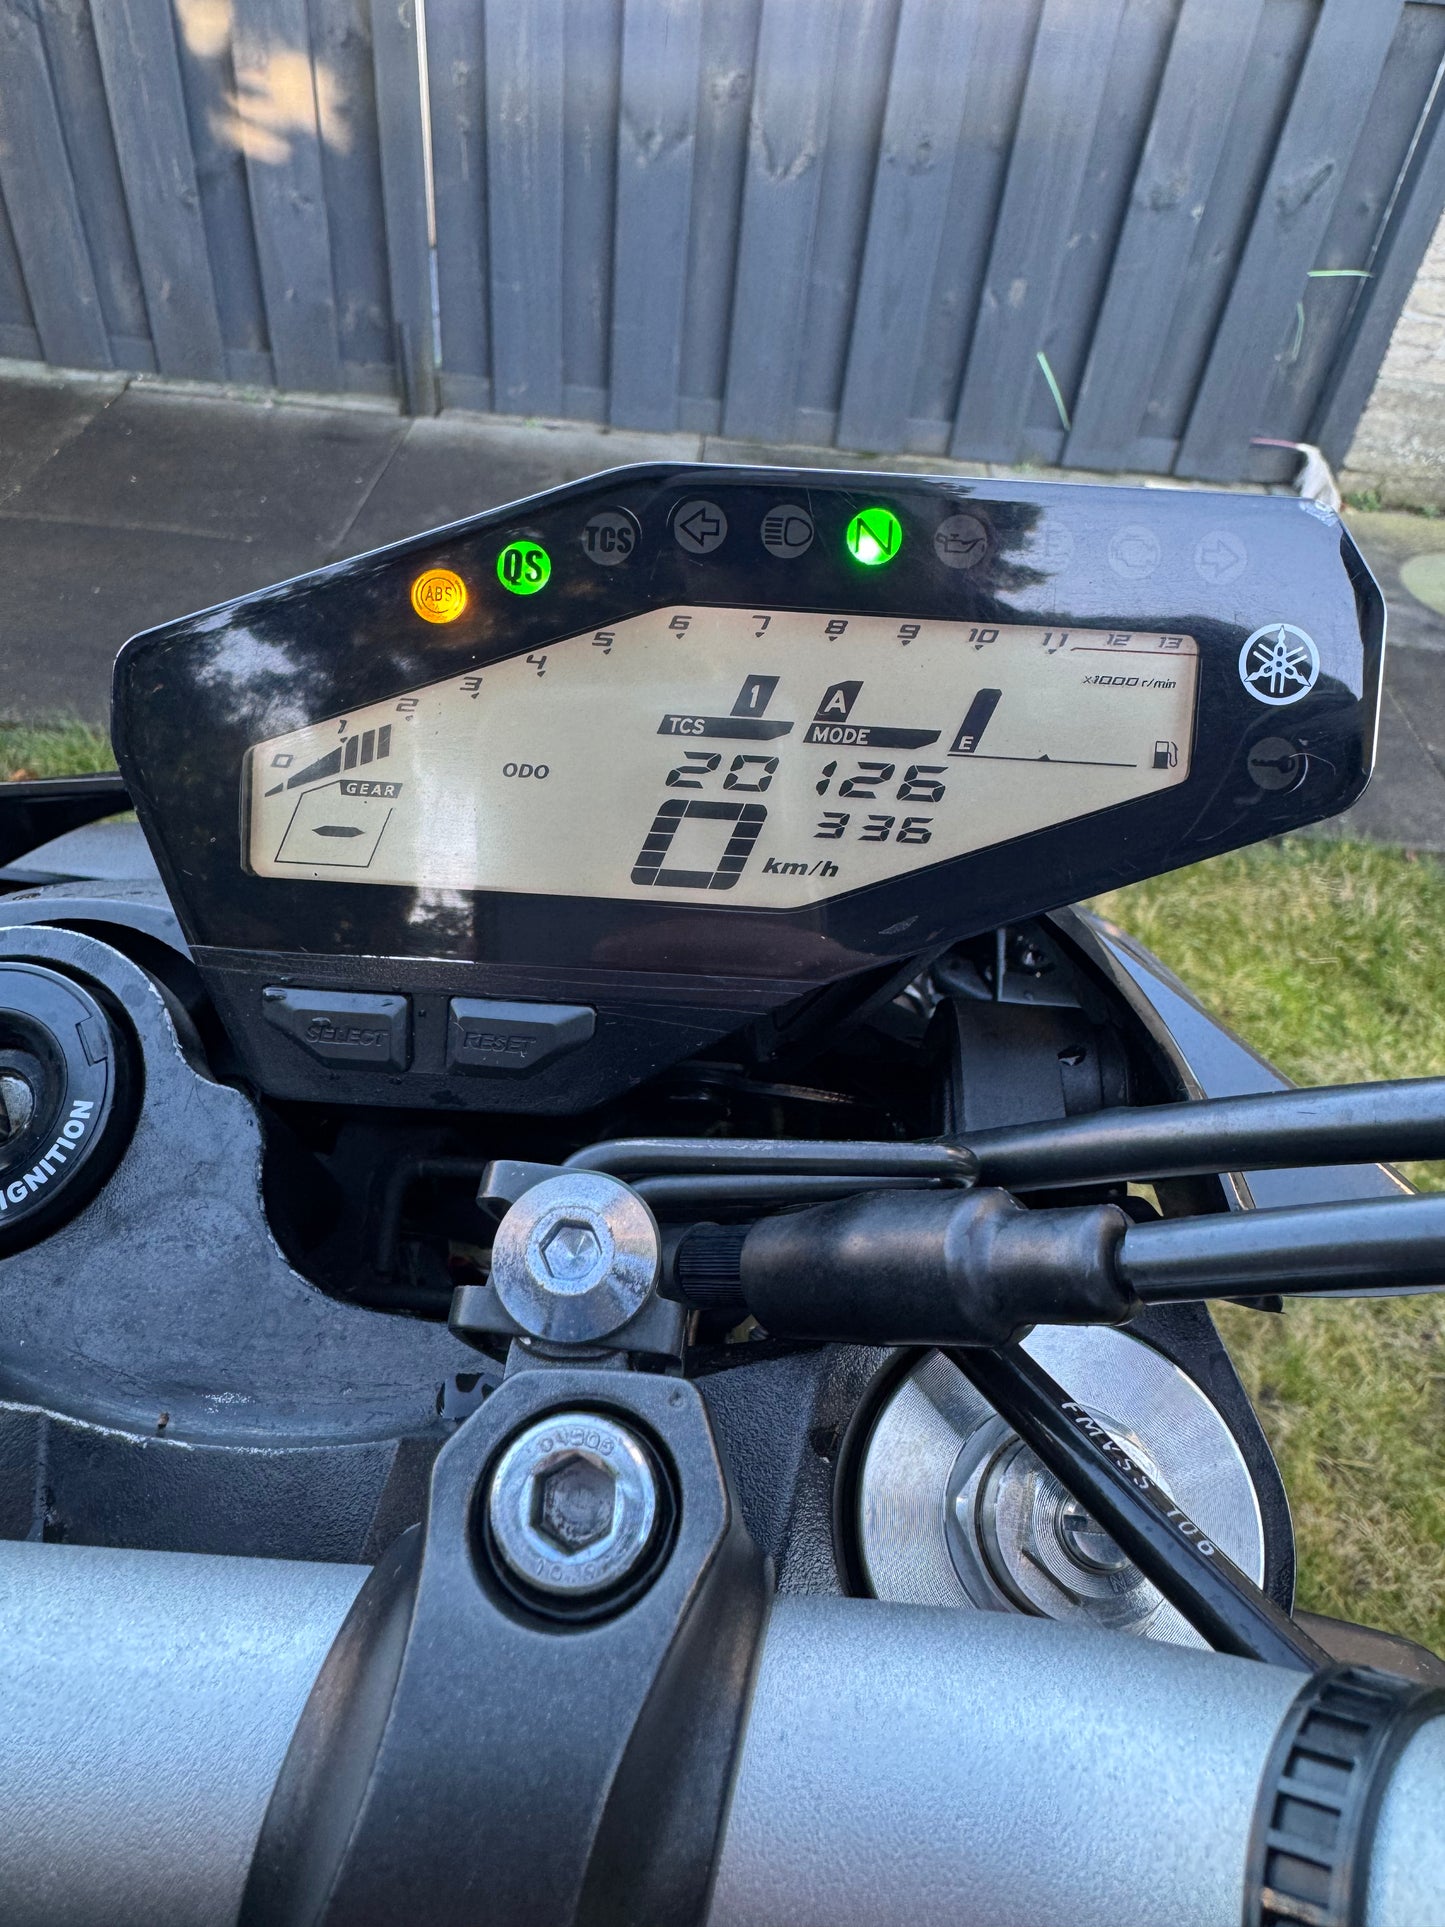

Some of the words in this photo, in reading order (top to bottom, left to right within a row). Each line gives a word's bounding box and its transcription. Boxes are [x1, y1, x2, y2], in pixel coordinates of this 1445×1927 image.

[586, 526, 632, 553] TCS
[854, 516, 893, 557] N
[503, 549, 544, 585] QS
[425, 586, 452, 602] ABS
[669, 615, 692, 630] 6
[752, 615, 772, 630] 7
[824, 620, 848, 634] 8
[897, 624, 921, 639] 9
[968, 628, 999, 643] 10
[592, 632, 616, 647] 5
[1042, 632, 1068, 647] 11
[1105, 633, 1132, 646] 12
[1158, 636, 1183, 649] 13
[526, 654, 547, 669] 4
[460, 676, 483, 691] 3
[1141, 679, 1176, 689] r/min
[749, 684, 760, 708] 1
[824, 690, 847, 714] A
[396, 698, 419, 712] 2
[337, 719, 347, 734] 1
[669, 717, 705, 735] TCS
[812, 726, 870, 745] MODE
[958, 736, 974, 750] E
[271, 753, 294, 768] 0
[503, 763, 550, 779] ODO
[346, 783, 395, 797] GEAR
[813, 811, 934, 844] 336
[630, 799, 768, 890] 0
[762, 857, 839, 877] km/h
[304, 1024, 392, 1047] SELECT
[464, 1031, 536, 1054] RESET
[0, 1100, 94, 1210] IGNITION
[1062, 1402, 1156, 1489] FMVSS
[1167, 1506, 1214, 1556] 106
